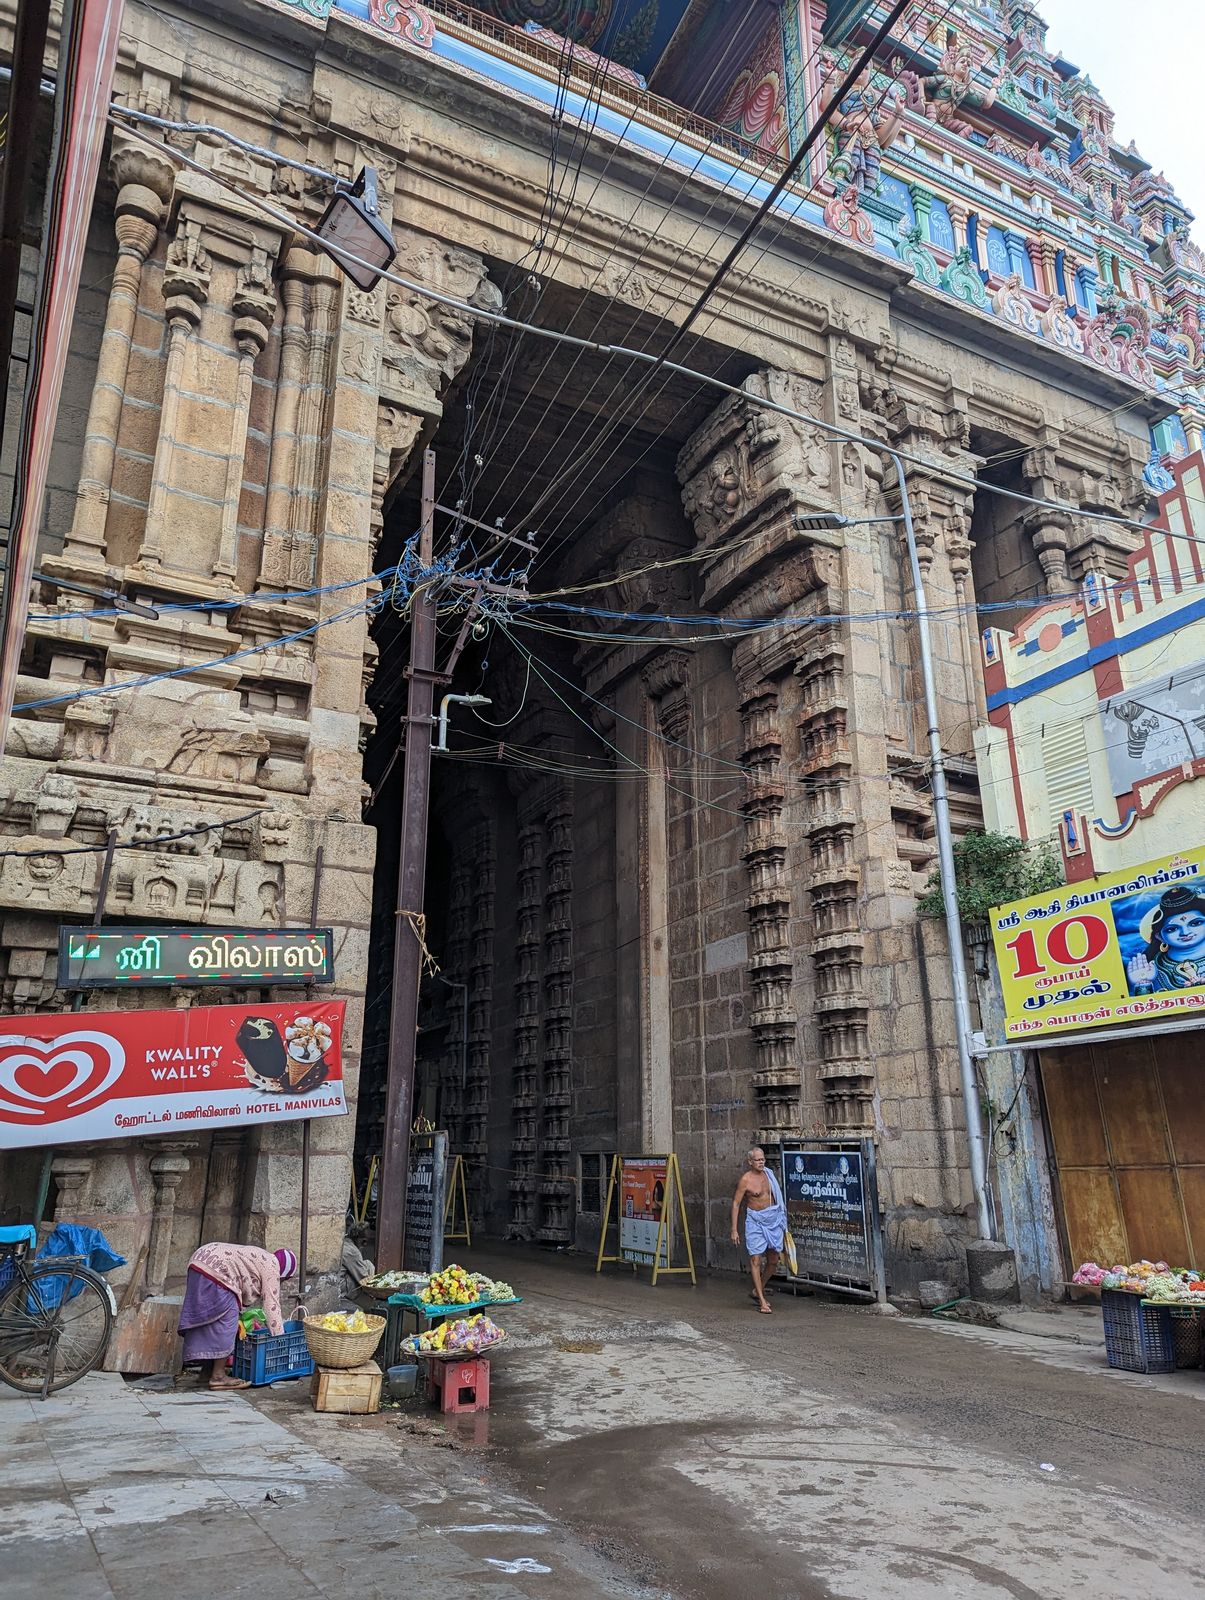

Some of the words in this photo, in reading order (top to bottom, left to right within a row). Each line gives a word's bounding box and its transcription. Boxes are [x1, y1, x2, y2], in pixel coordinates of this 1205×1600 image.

[1024, 900, 1062, 920] ஆதி
[1066, 863, 1199, 911] தியானலிங்கா
[188, 936, 324, 969] விலாஸ்
[1006, 914, 1110, 979] 10
[1034, 965, 1091, 989] ரூபாய்
[1023, 979, 1112, 1010] முதல்
[1009, 1019, 1043, 1033] எந்த
[1046, 1006, 1112, 1026] பொருள்
[145, 1045, 223, 1063] KWALITY
[150, 1065, 211, 1081] WALL'S
[114, 1109, 172, 1128] ஹோட்டல்
[175, 1103, 241, 1120] மணிவிலாஸ்
[246, 1101, 282, 1115] HOTEL
[284, 1096, 342, 1111] MANIVILAS
